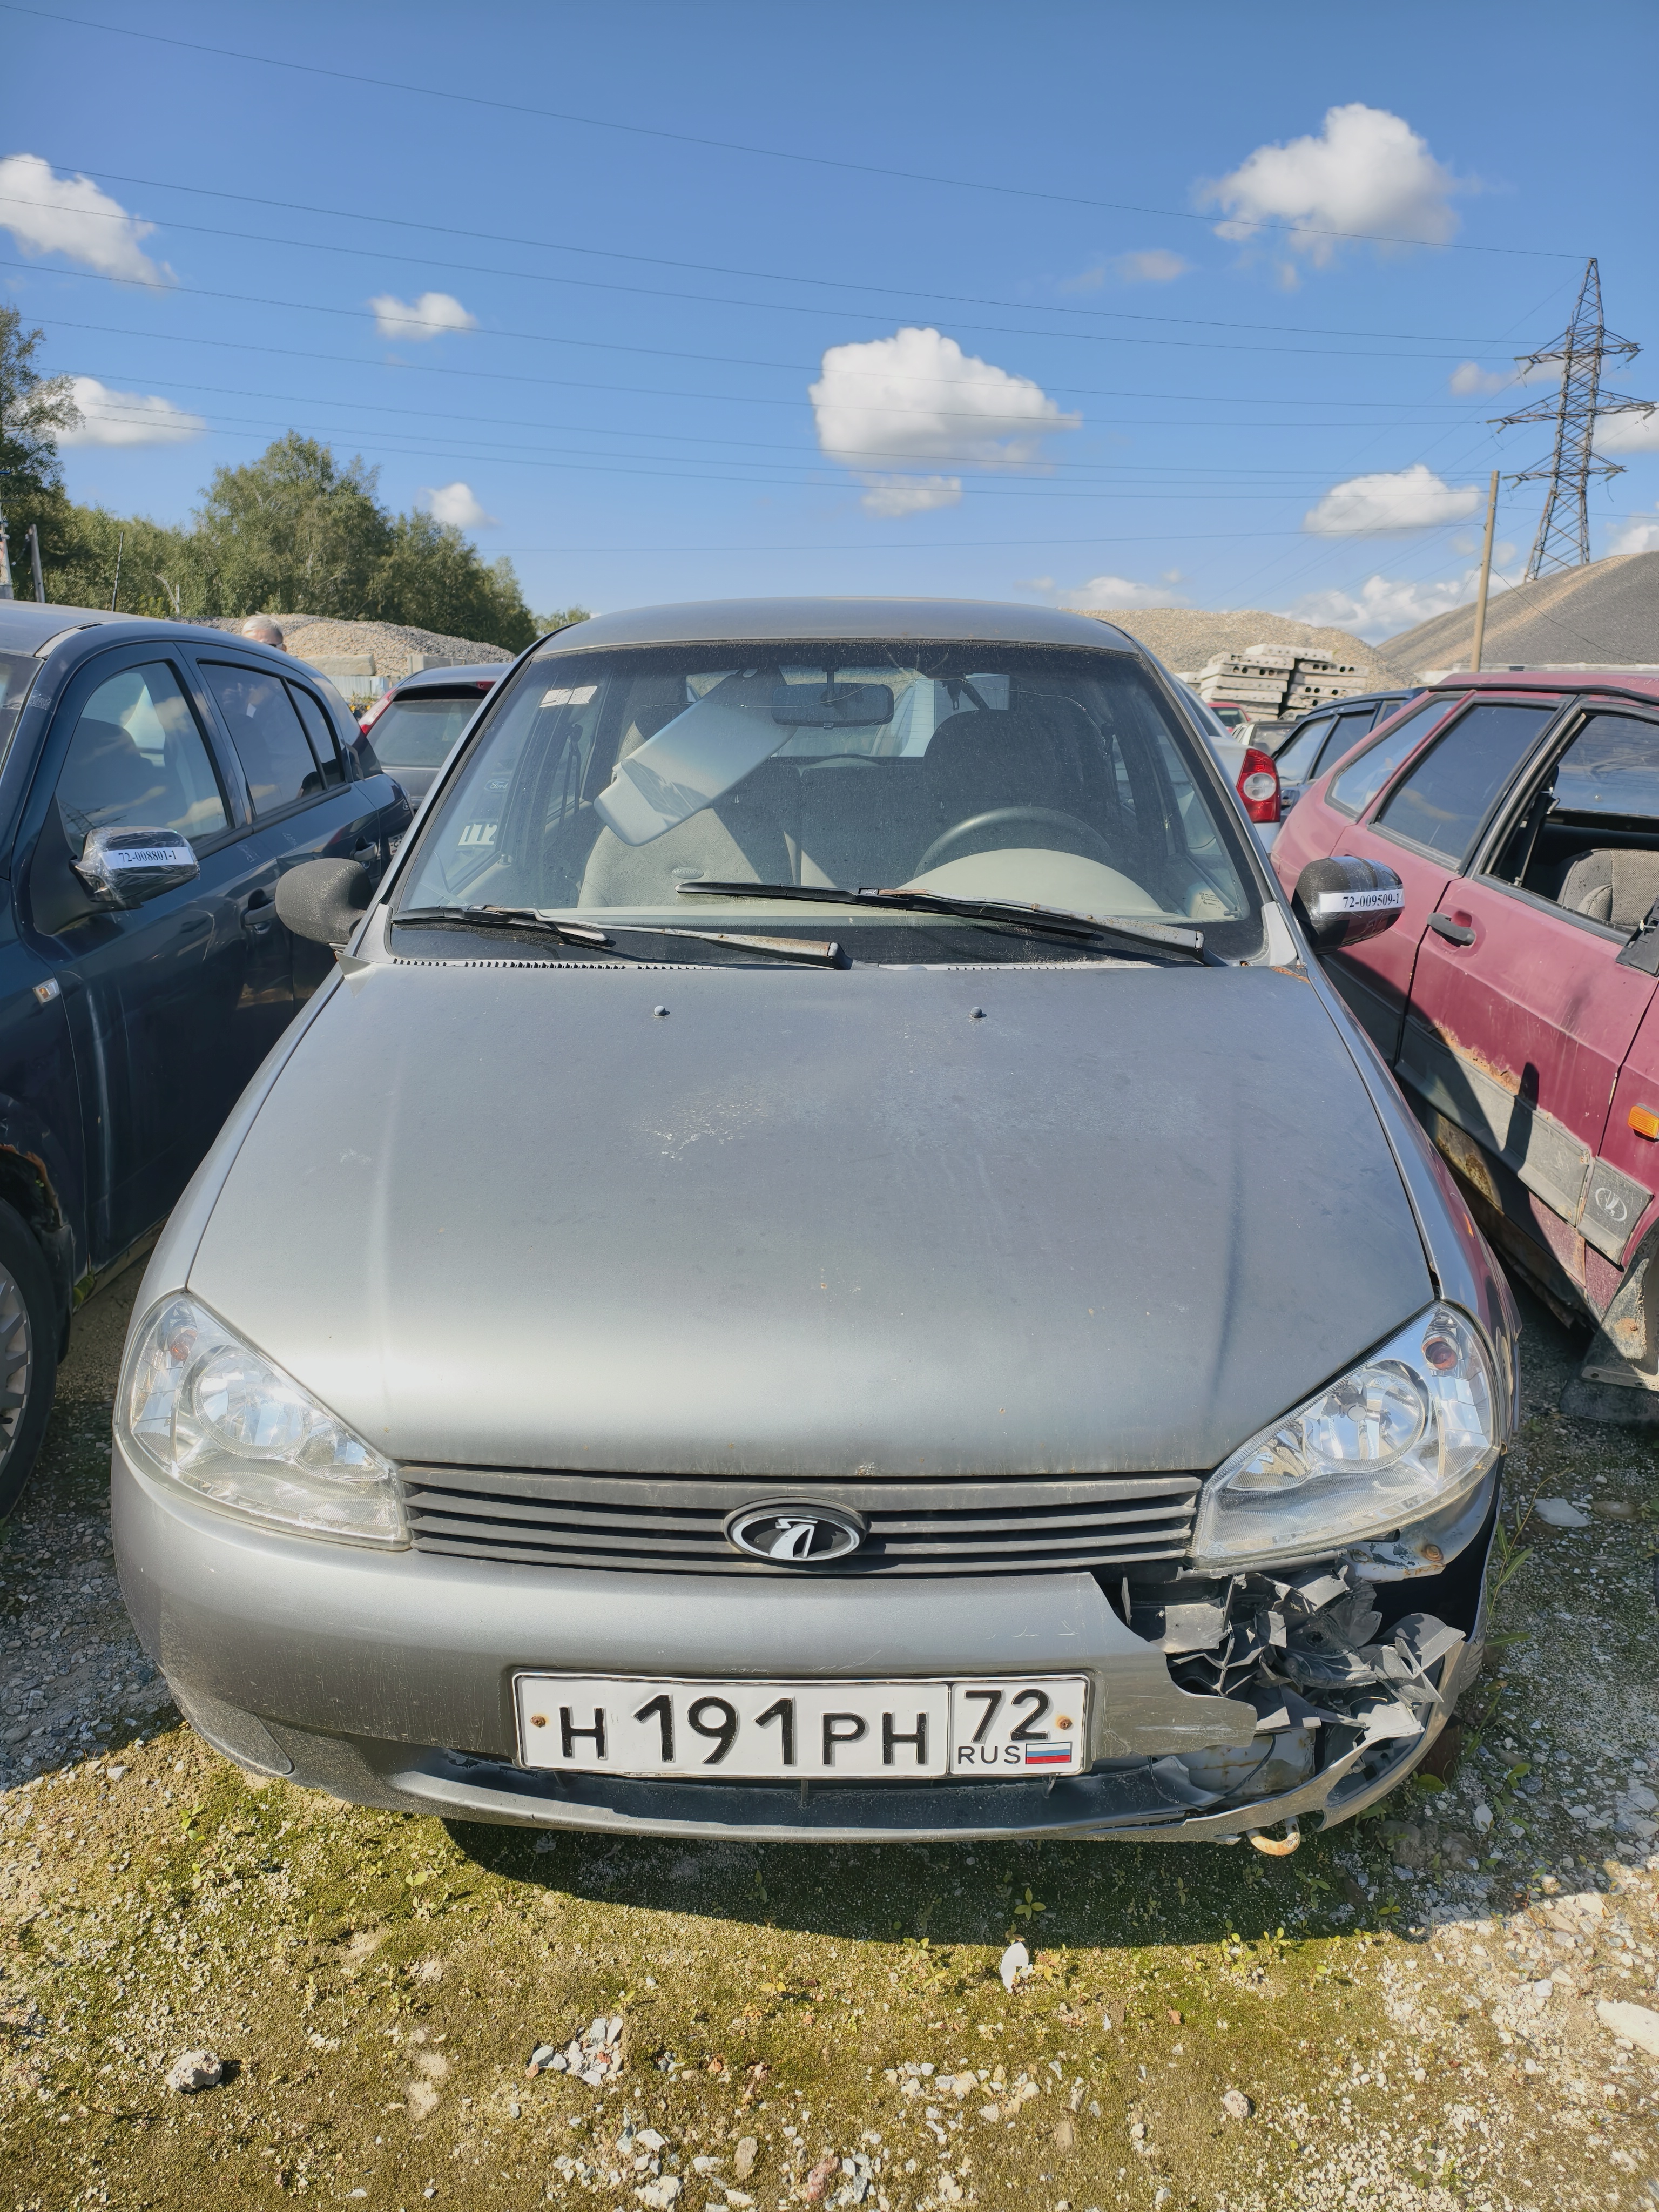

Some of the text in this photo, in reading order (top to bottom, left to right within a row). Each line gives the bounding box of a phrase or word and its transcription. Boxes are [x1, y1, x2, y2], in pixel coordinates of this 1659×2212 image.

[118, 849, 177, 863] 72-008801-1
[1343, 893, 1399, 908] 72-009509-1
[559, 1688, 1050, 1765] Н191РН 72
[957, 1745, 1021, 1764] RUS
